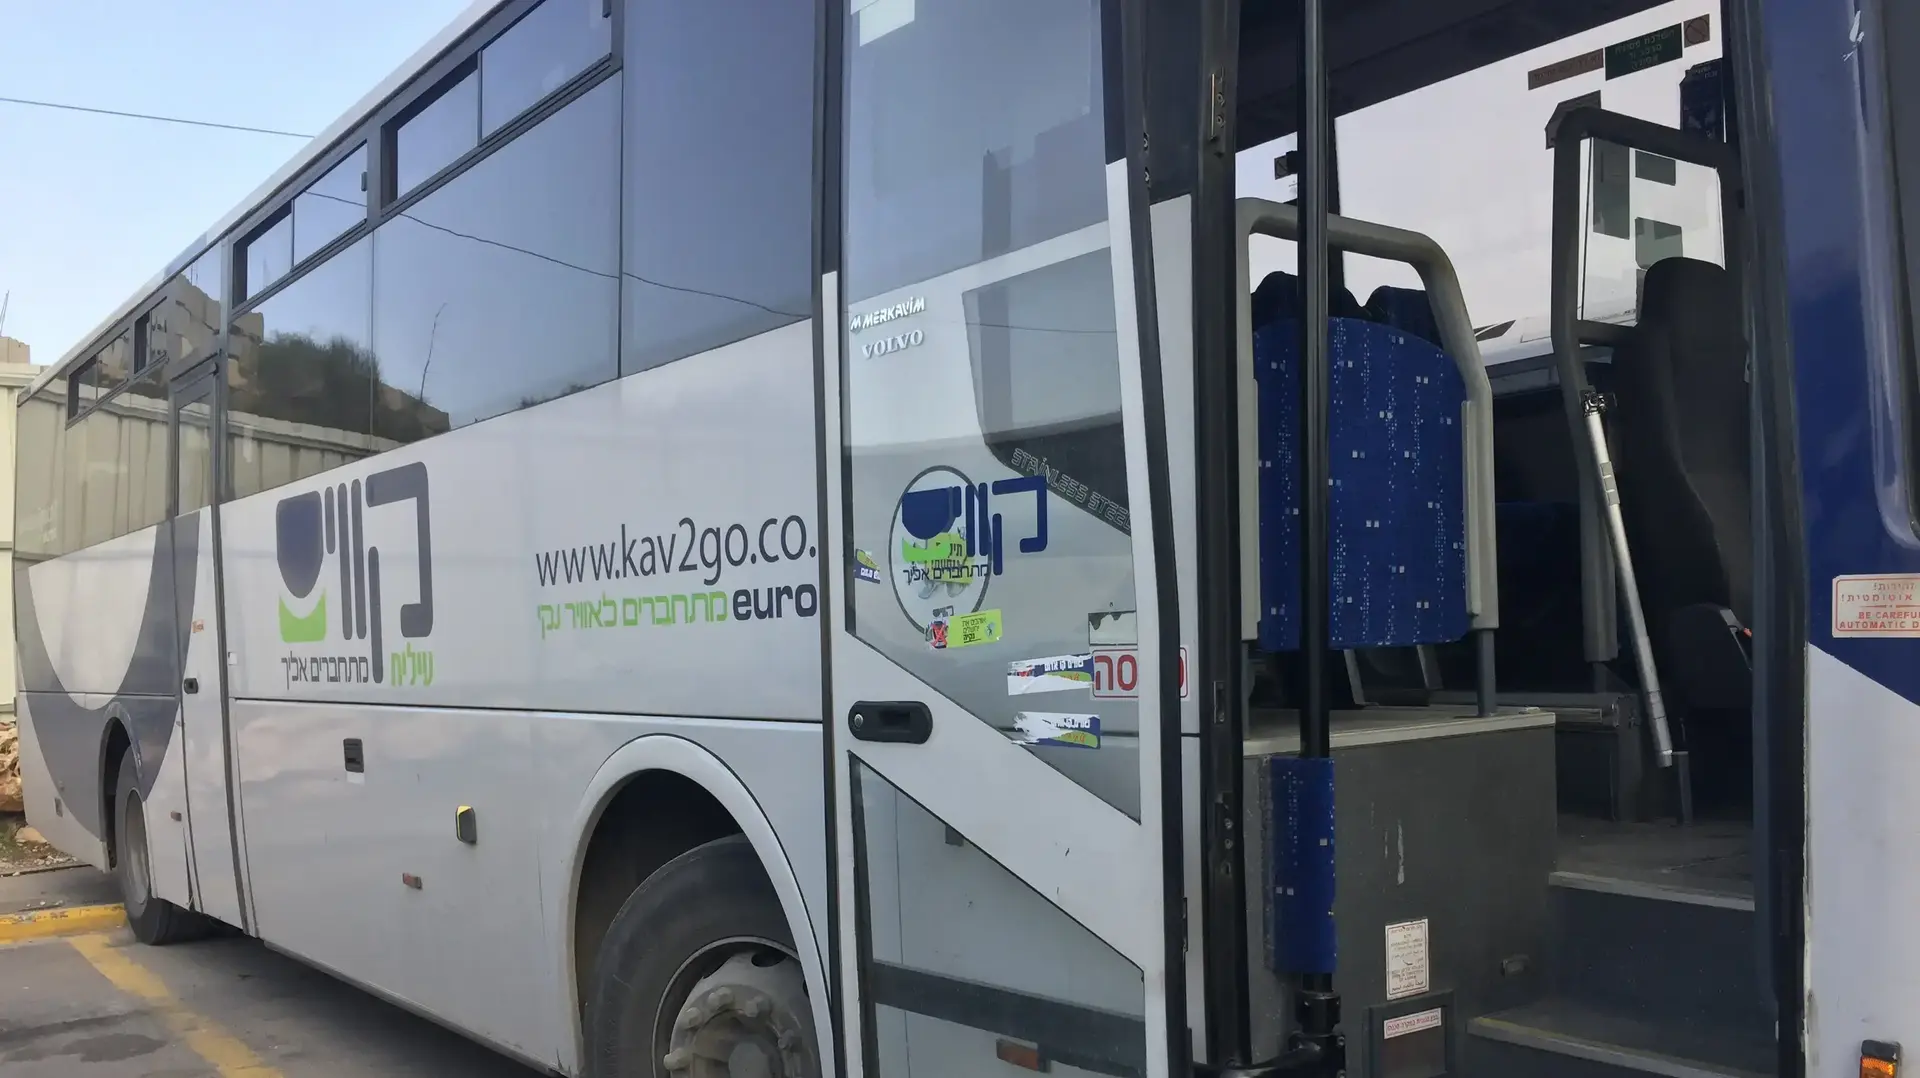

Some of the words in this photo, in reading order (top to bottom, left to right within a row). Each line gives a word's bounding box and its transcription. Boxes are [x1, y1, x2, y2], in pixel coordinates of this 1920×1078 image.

[861, 329, 924, 359] VOLVO
[903, 563, 931, 586] אליך
[933, 563, 989, 580] מתחברים
[564, 590, 618, 629] לאוויר
[622, 590, 728, 626] מתחברים
[732, 583, 818, 621] euro
[1858, 611, 1871, 620] BE
[1875, 611, 1920, 620] CAREFU
[537, 602, 561, 640] נקי
[1839, 621, 1906, 629] AUTOMATIC
[280, 650, 309, 691] אליך
[310, 656, 369, 684] מתחברים
